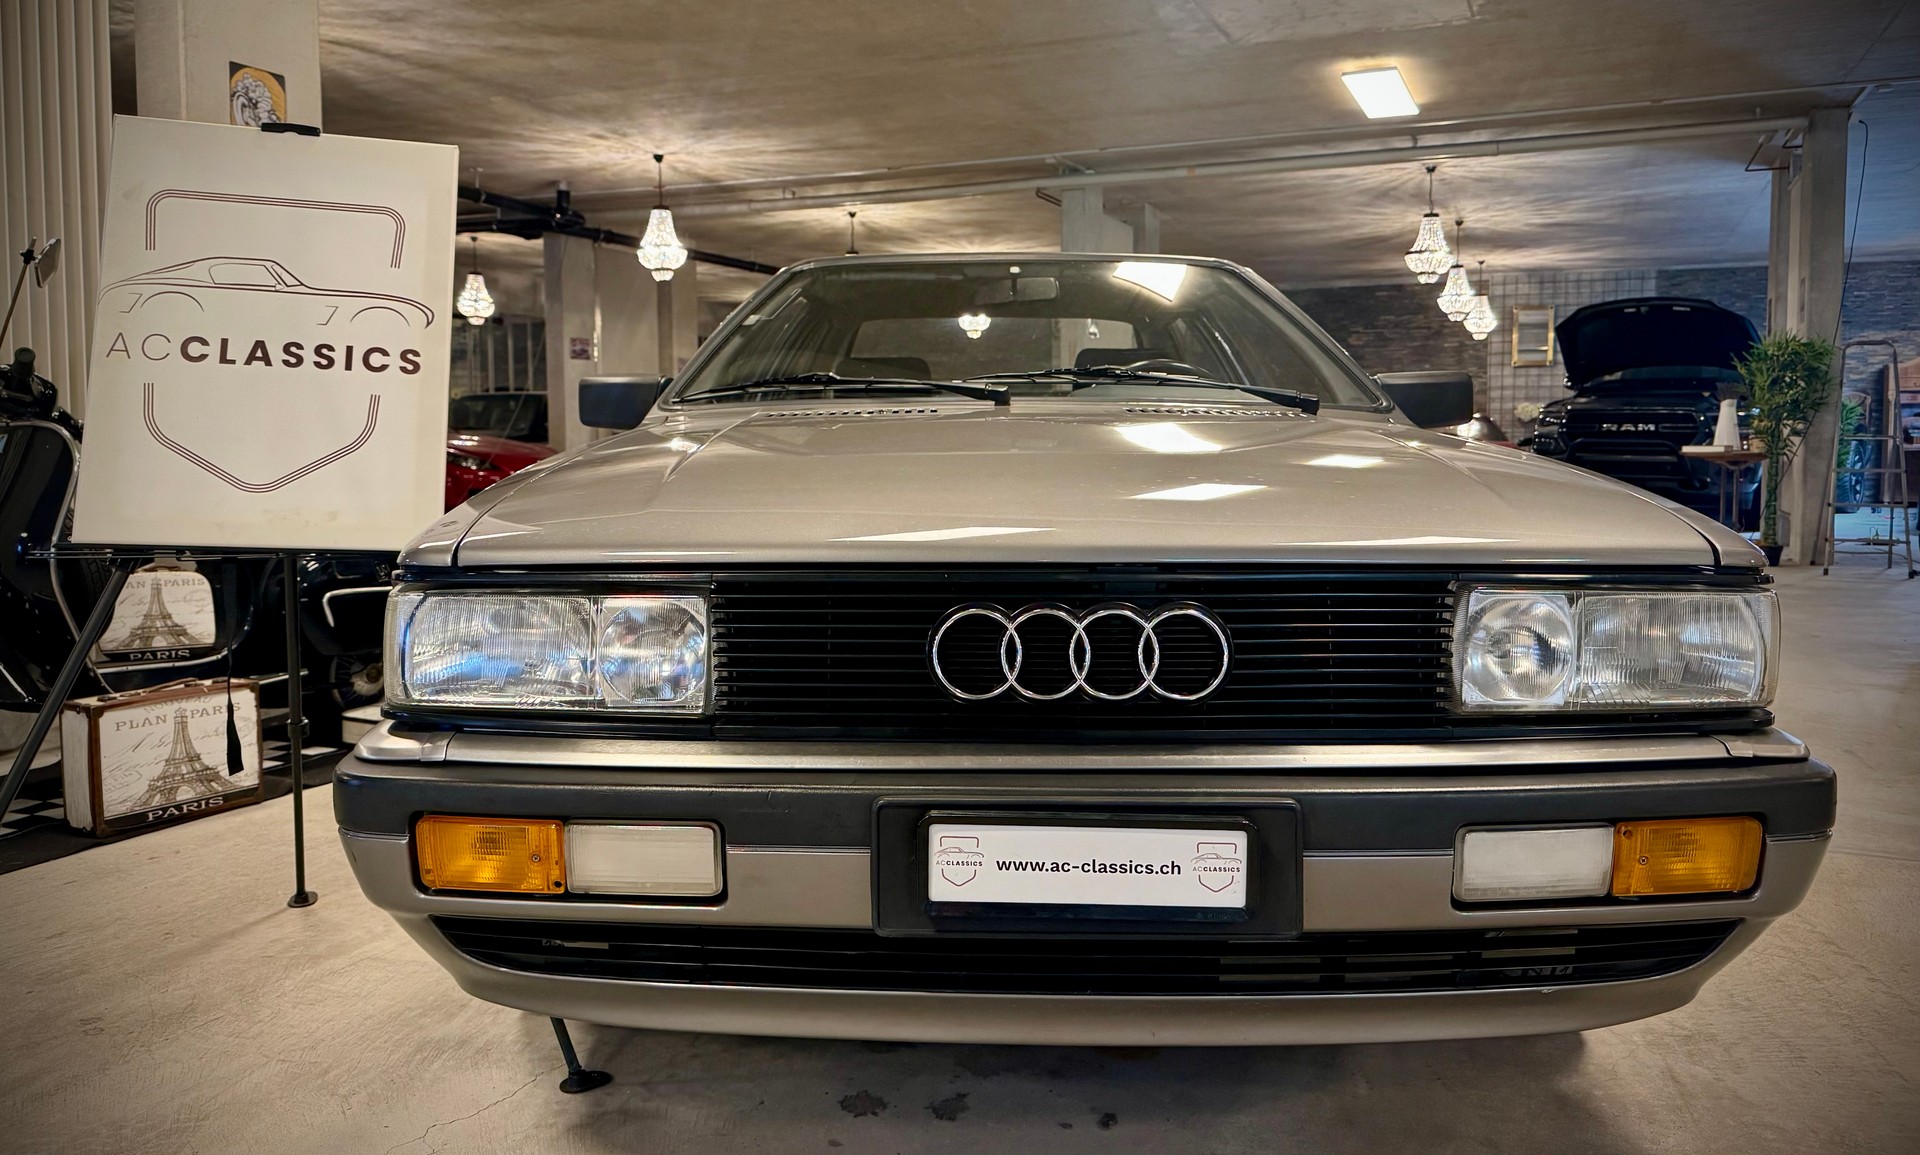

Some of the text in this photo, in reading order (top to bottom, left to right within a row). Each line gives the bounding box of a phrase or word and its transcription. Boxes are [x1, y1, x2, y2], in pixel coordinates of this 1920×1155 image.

[105, 331, 423, 376] ACCLASSICS
[1602, 423, 1656, 431] RAM
[124, 577, 206, 589] AN PARIS
[129, 650, 191, 661] PARIS
[114, 702, 241, 732] PLAN PARS
[145, 796, 225, 822] PARIS
[995, 858, 1182, 876] www.ac-classics.ch
